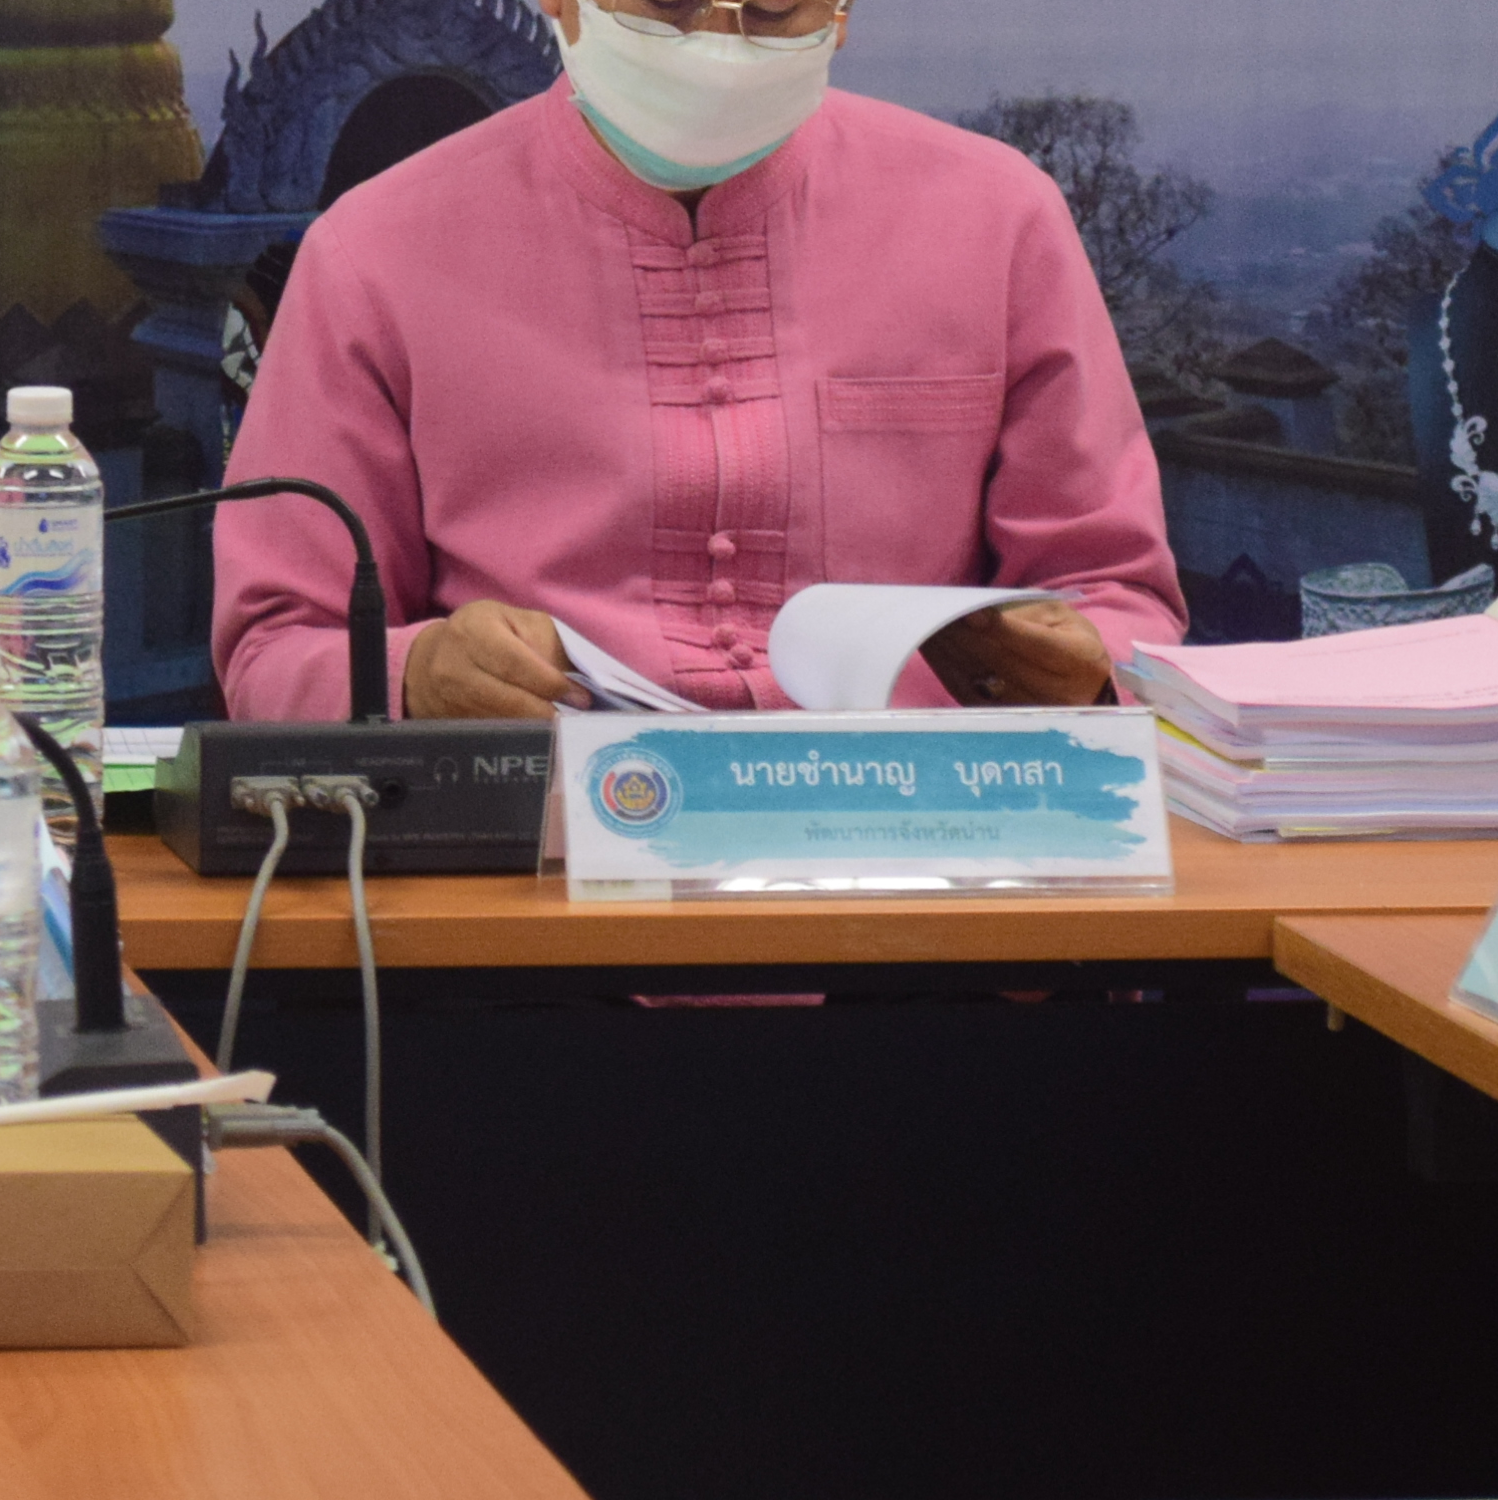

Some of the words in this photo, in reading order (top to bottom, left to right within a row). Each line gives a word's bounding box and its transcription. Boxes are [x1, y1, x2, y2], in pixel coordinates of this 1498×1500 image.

[473, 755, 548, 777] NPE
[730, 750, 916, 796] นายชำนาญ
[955, 760, 1064, 798] บุดาสา
